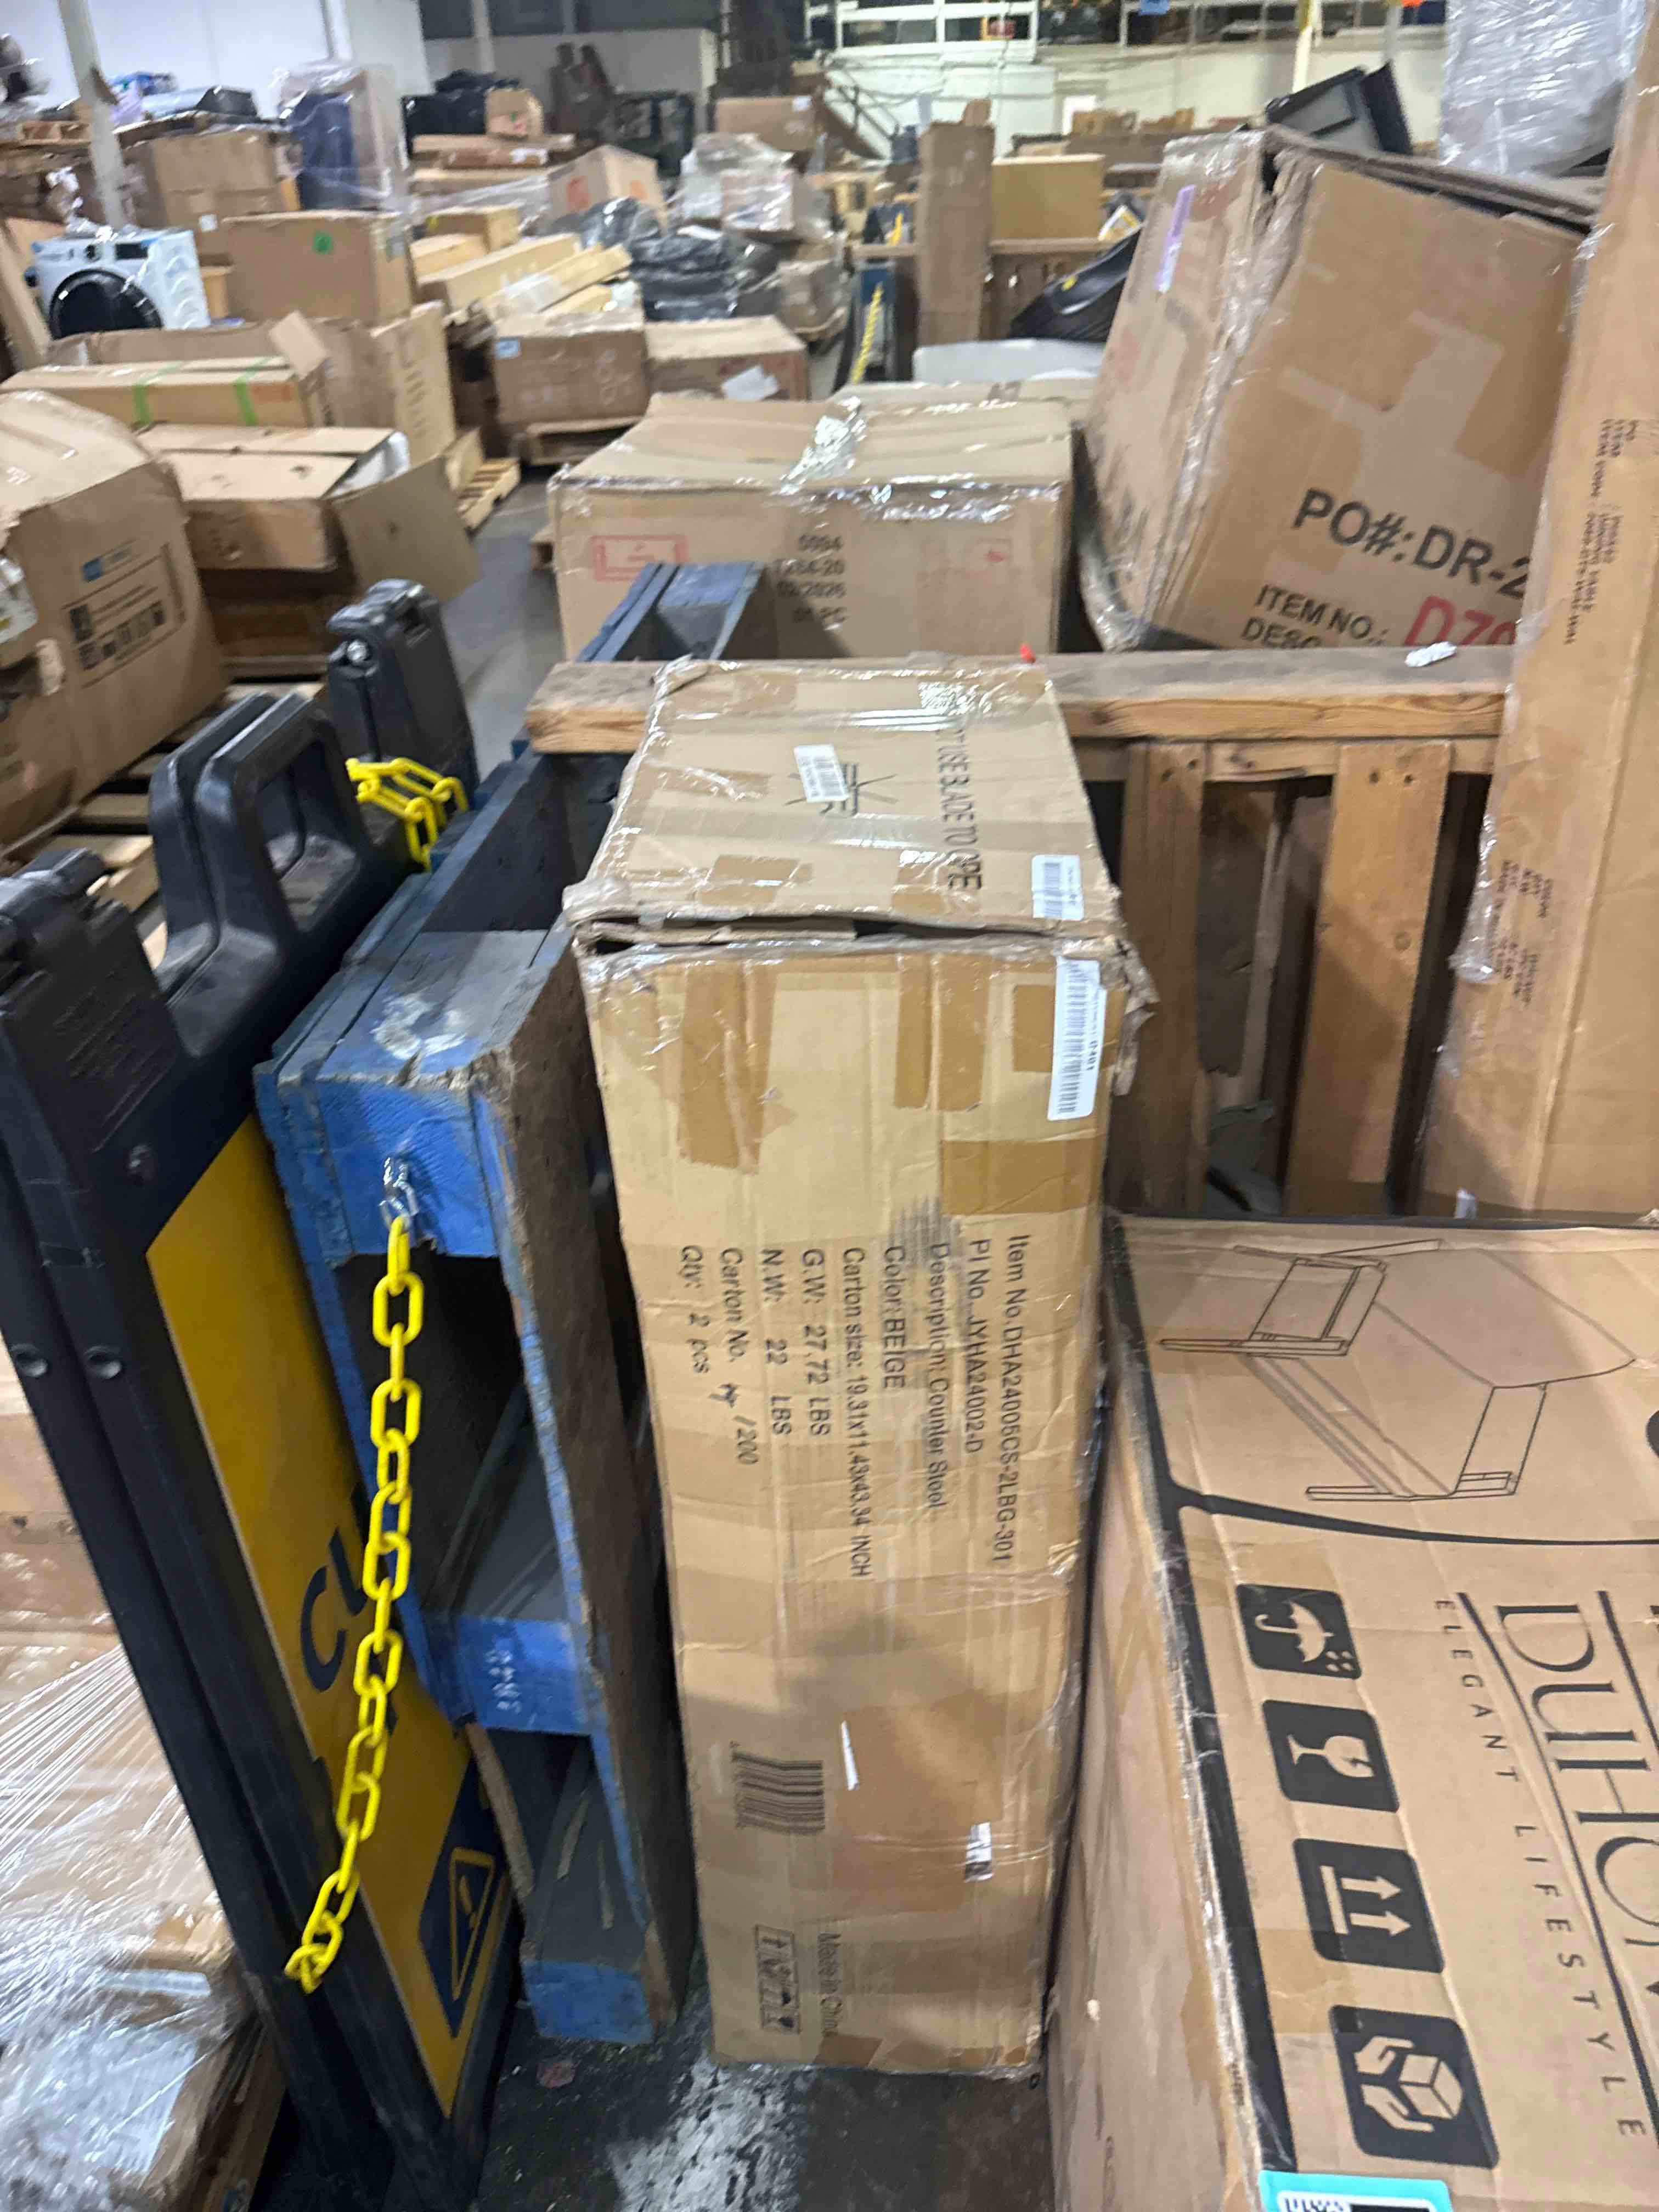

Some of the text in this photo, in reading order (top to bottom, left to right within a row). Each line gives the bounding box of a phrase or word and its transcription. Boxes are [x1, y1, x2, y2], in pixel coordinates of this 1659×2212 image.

[1254, 584, 1329, 625] ITEM
[678, 1245, 703, 1288] Qty:
[968, 1239, 991, 1262] PI
[1006, 1234, 1030, 1282] Item
[719, 1247, 747, 1322] Carton
[843, 1247, 866, 1317] Carton
[765, 1339, 789, 1365] 22
[804, 1325, 830, 1385] 27.72
[845, 1323, 868, 1368] size:
[770, 1395, 792, 1436] LBS
[808, 1397, 831, 1436] LBS
[928, 1377, 950, 1454] Counter
[927, 1460, 948, 1508] Stool
[851, 1534, 872, 1578] INCH
[1434, 1599, 1646, 2135] ELEGANT LIFESTYLE
